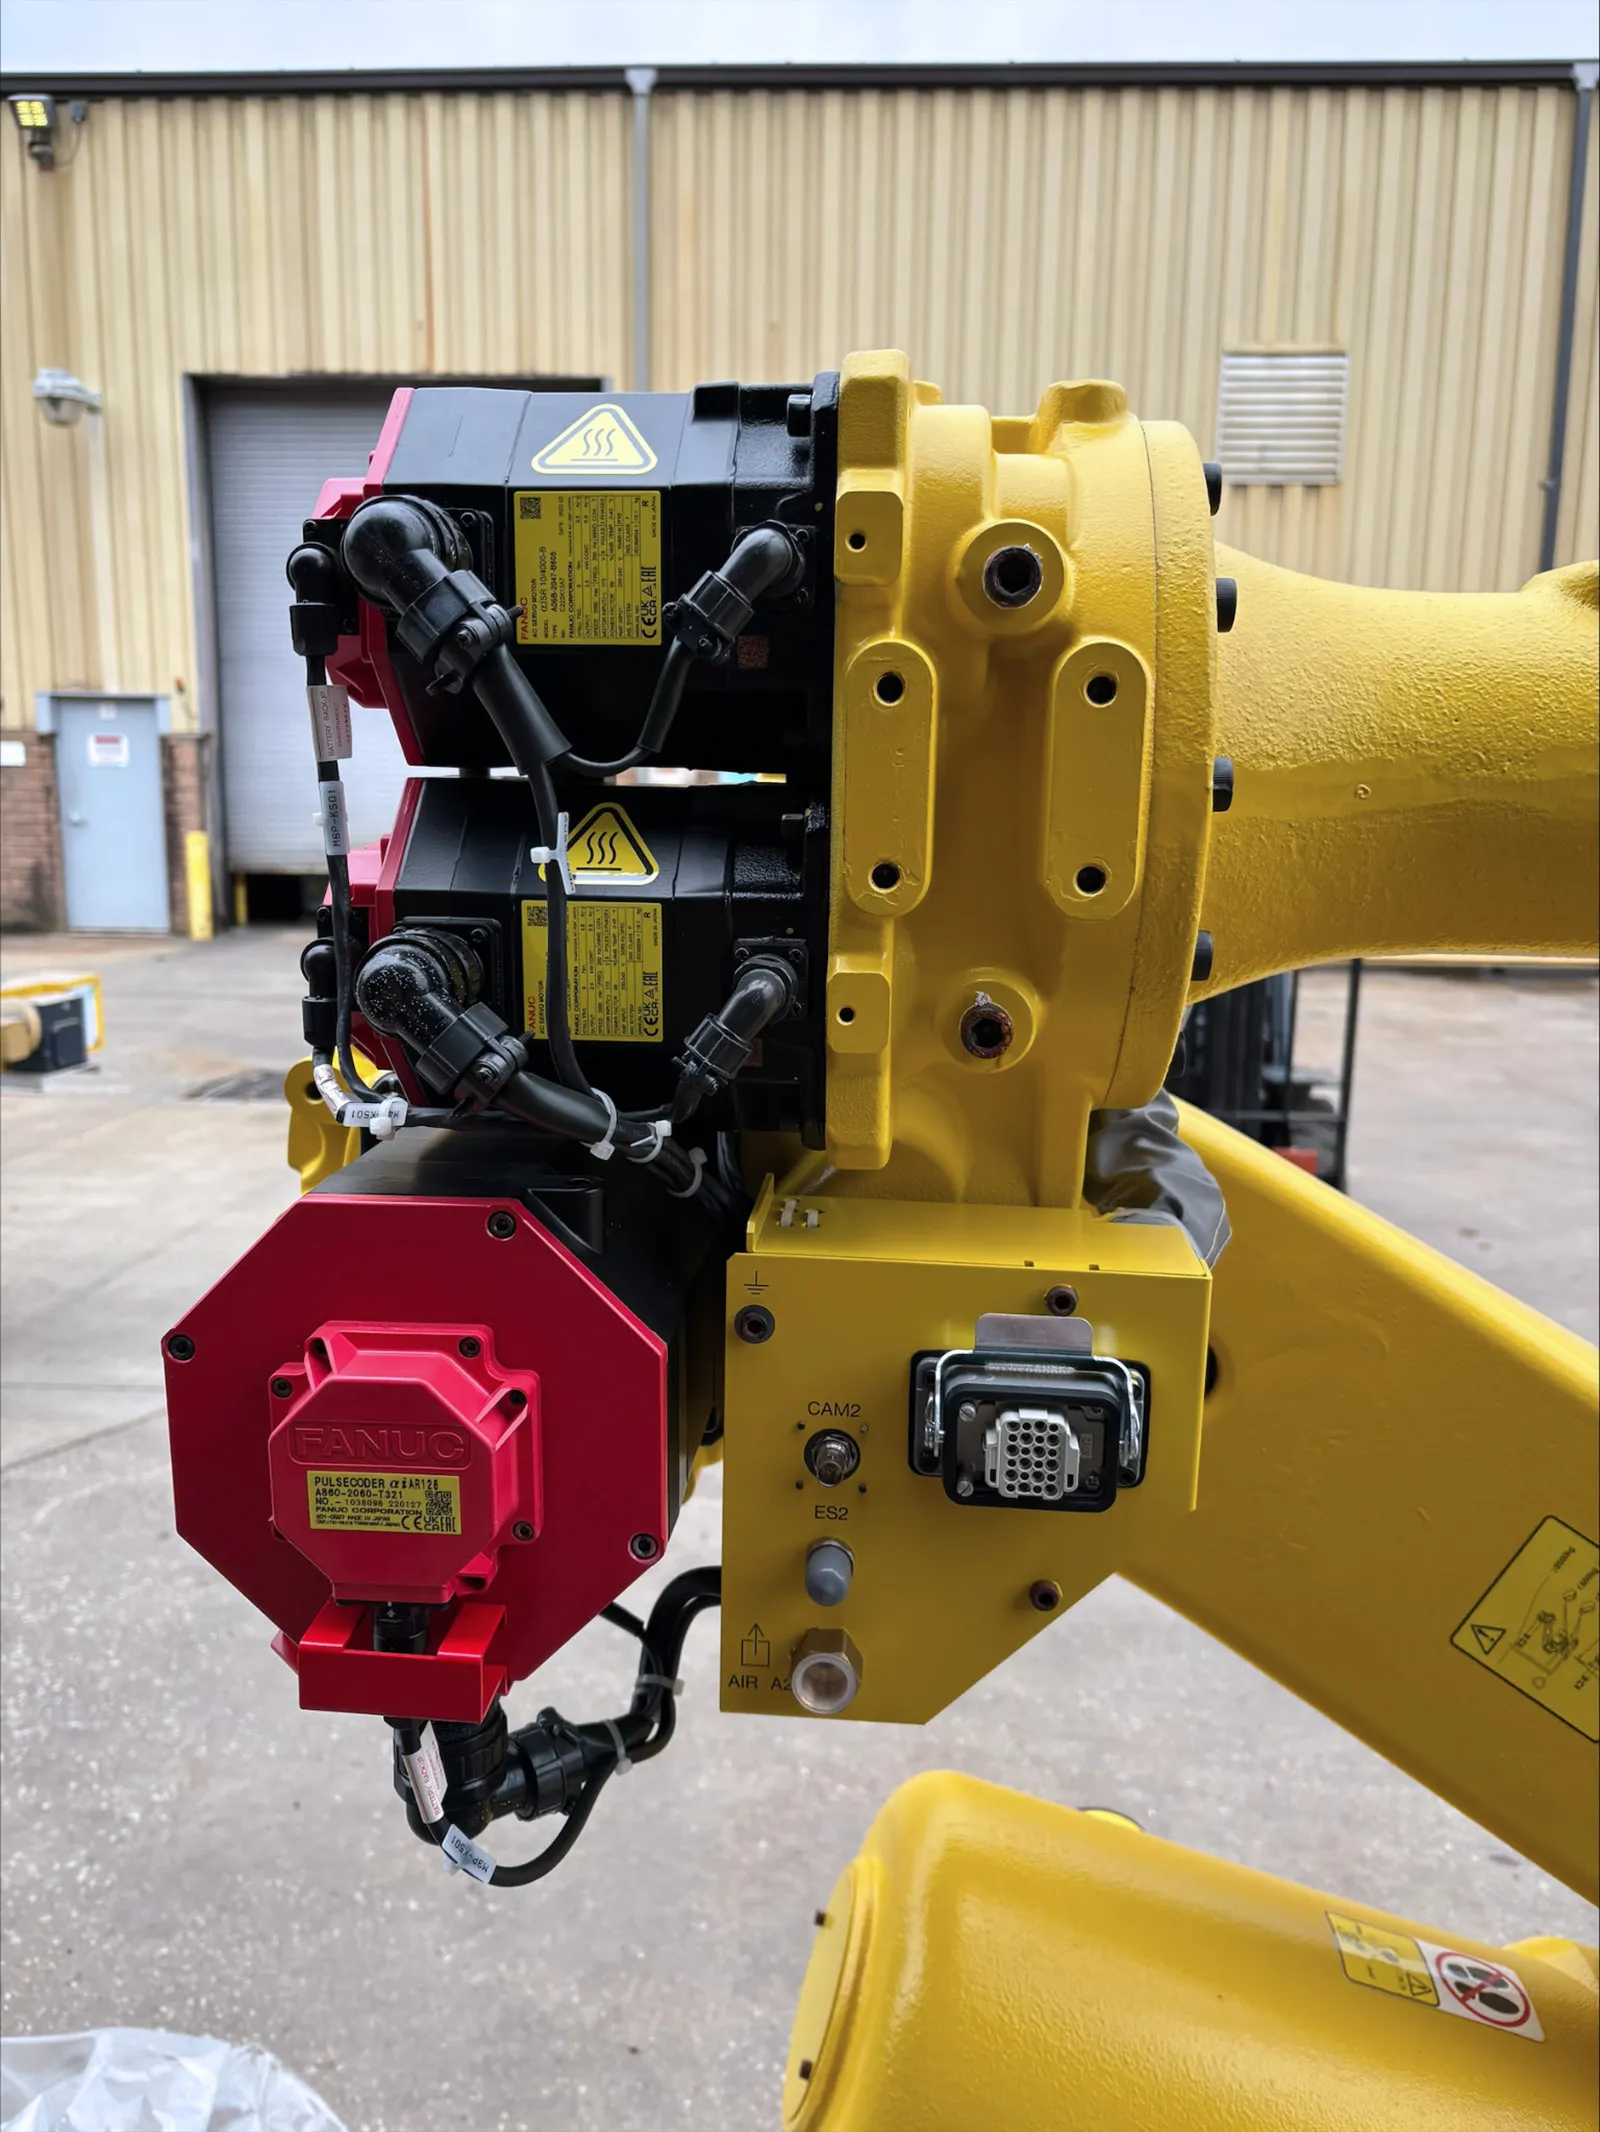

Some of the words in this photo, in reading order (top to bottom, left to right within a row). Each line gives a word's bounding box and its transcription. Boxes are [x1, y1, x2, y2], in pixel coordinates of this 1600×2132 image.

[532, 629, 537, 638] AC
[325, 725, 335, 758] BATTERY
[540, 1026, 544, 1034] AC
[807, 1400, 861, 1419] CAM2
[292, 1426, 465, 1462] FANUC
[314, 1476, 385, 1488] PULSECODER
[315, 1489, 403, 1499] A860-2060-T321
[351, 1507, 422, 1516] CORPORATION
[814, 1505, 849, 1521] ES2
[728, 1674, 758, 1690] AIR
